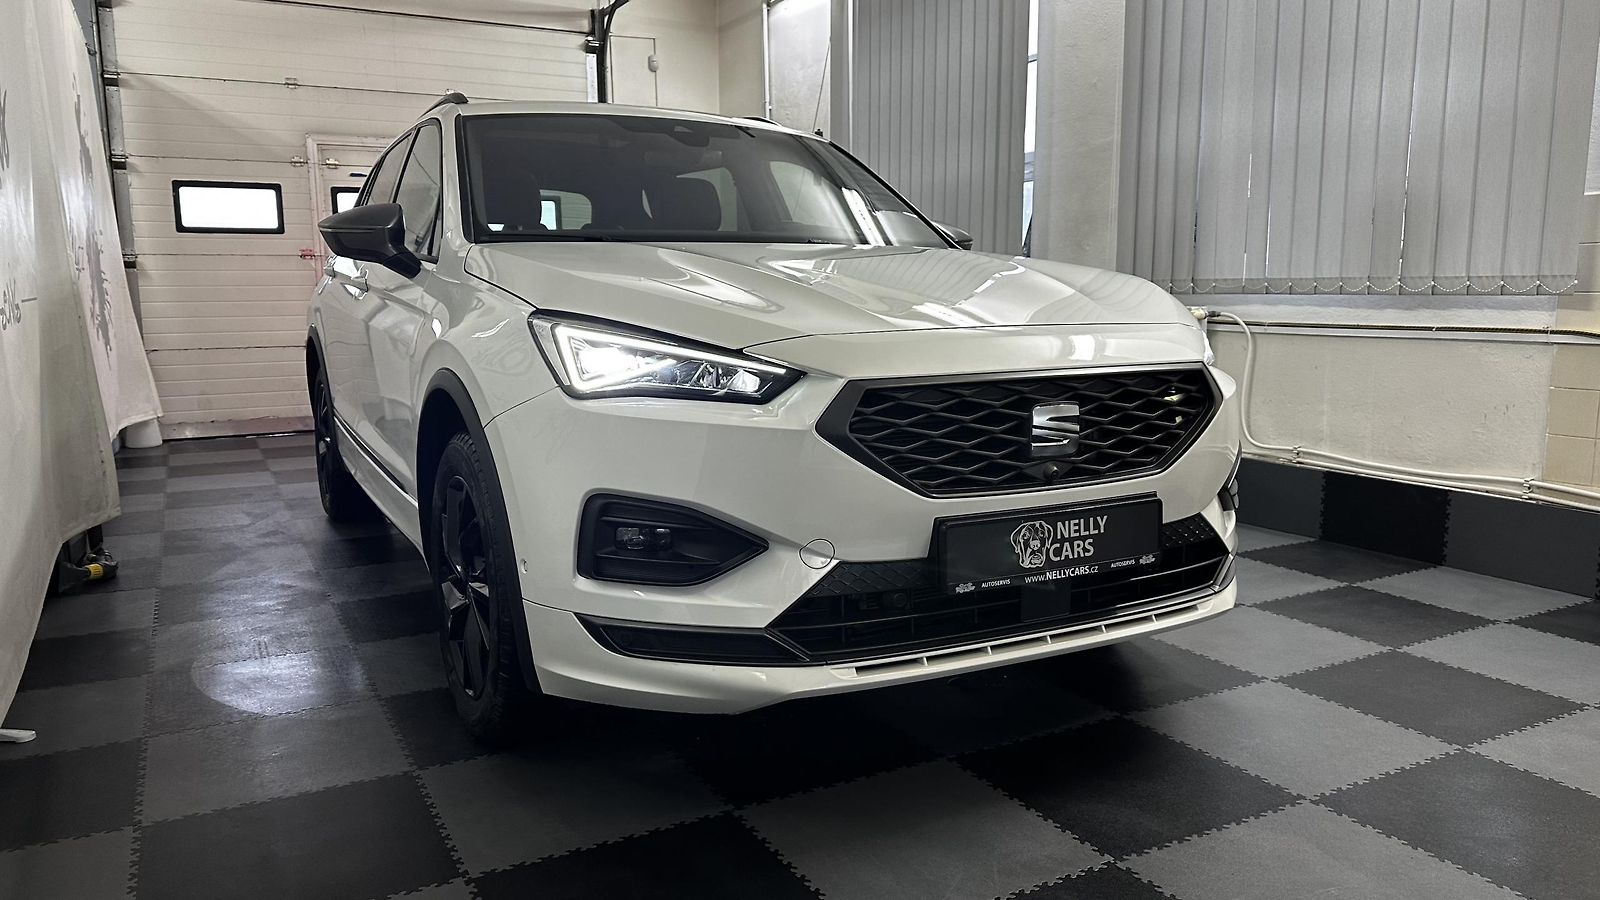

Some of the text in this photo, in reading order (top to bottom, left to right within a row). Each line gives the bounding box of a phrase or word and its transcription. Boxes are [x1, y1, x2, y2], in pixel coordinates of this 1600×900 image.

[1056, 515, 1108, 539] NELLY
[1049, 538, 1094, 562] CARS
[1110, 559, 1136, 569] AUTOSERVIS
[981, 578, 1011, 588] AUTOSERVIS
